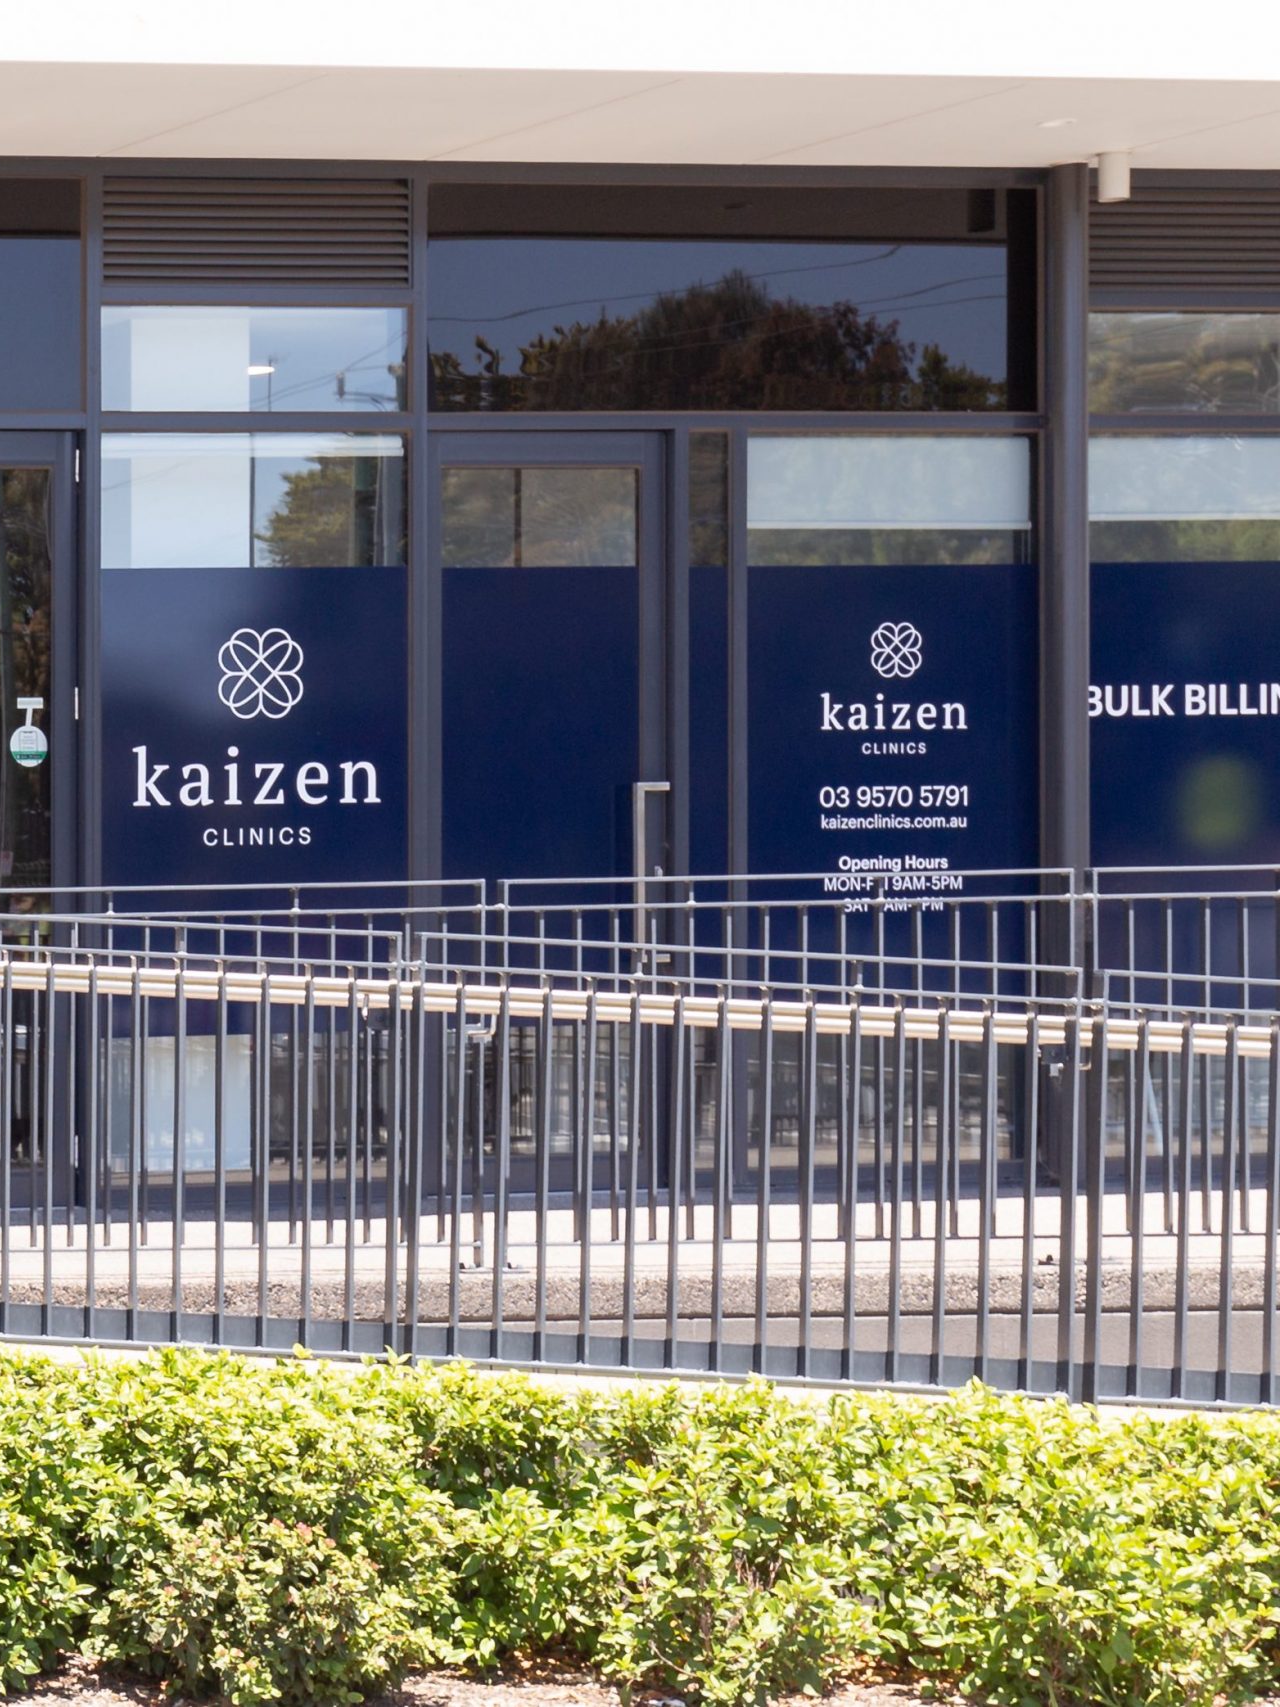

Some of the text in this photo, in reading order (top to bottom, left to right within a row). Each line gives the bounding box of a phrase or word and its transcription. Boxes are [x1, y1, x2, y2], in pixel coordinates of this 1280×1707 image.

[1088, 684, 1176, 717] BULK
[820, 692, 968, 731] kaizen
[861, 742, 927, 755] CLINICS
[132, 745, 382, 807] kaizen
[819, 784, 968, 808] 03 9570 5791
[820, 813, 968, 830] kaizenclinics.com.au
[202, 826, 311, 847] CLINICS
[838, 854, 949, 872] Opening Hours
[823, 875, 963, 892] MON-FI 9AM-5PM
[878, 897, 945, 912] AM-PM
